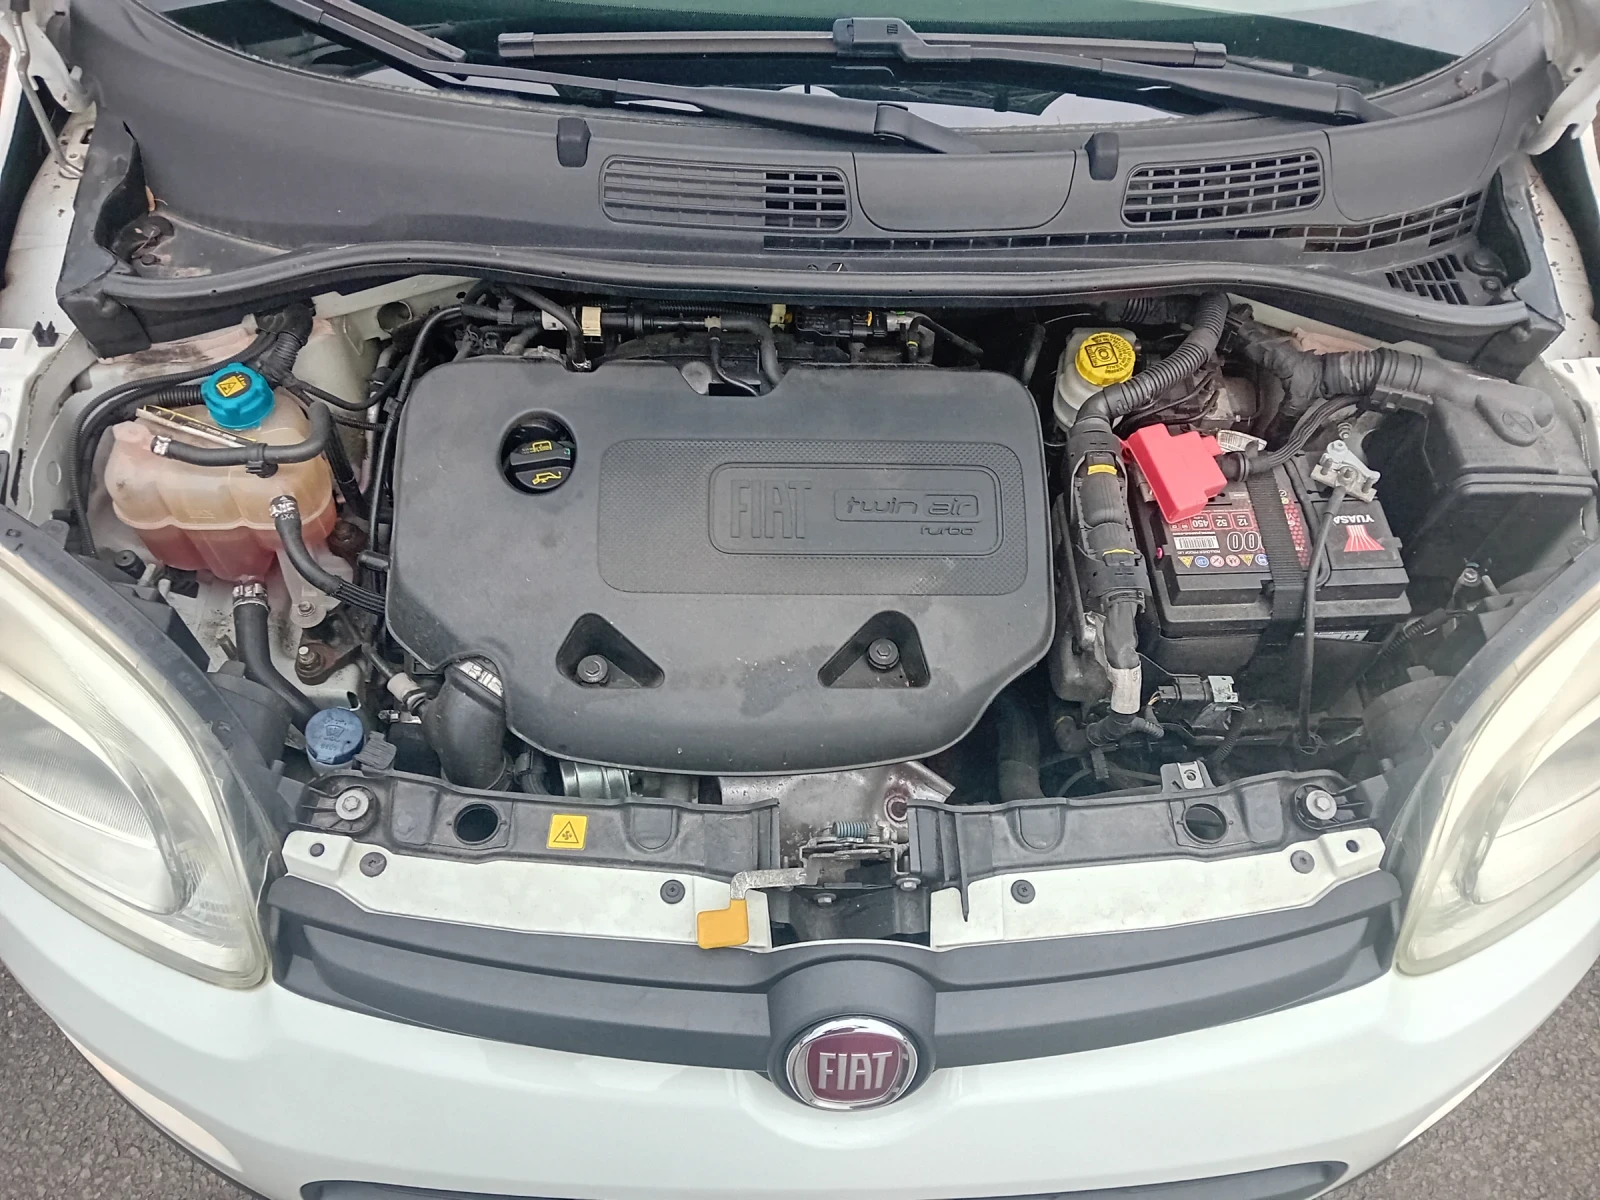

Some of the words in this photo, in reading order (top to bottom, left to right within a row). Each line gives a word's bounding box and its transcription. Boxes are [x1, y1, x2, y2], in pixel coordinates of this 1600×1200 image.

[730, 479, 812, 539] FIAT
[846, 496, 918, 515] twin
[927, 497, 972, 516] air
[1192, 519, 1209, 528] 450
[1215, 518, 1228, 527] 52
[1237, 518, 1249, 526] 12
[1333, 514, 1375, 524] YUASA
[920, 525, 975, 536] turbo
[818, 1051, 893, 1090] FIAT
